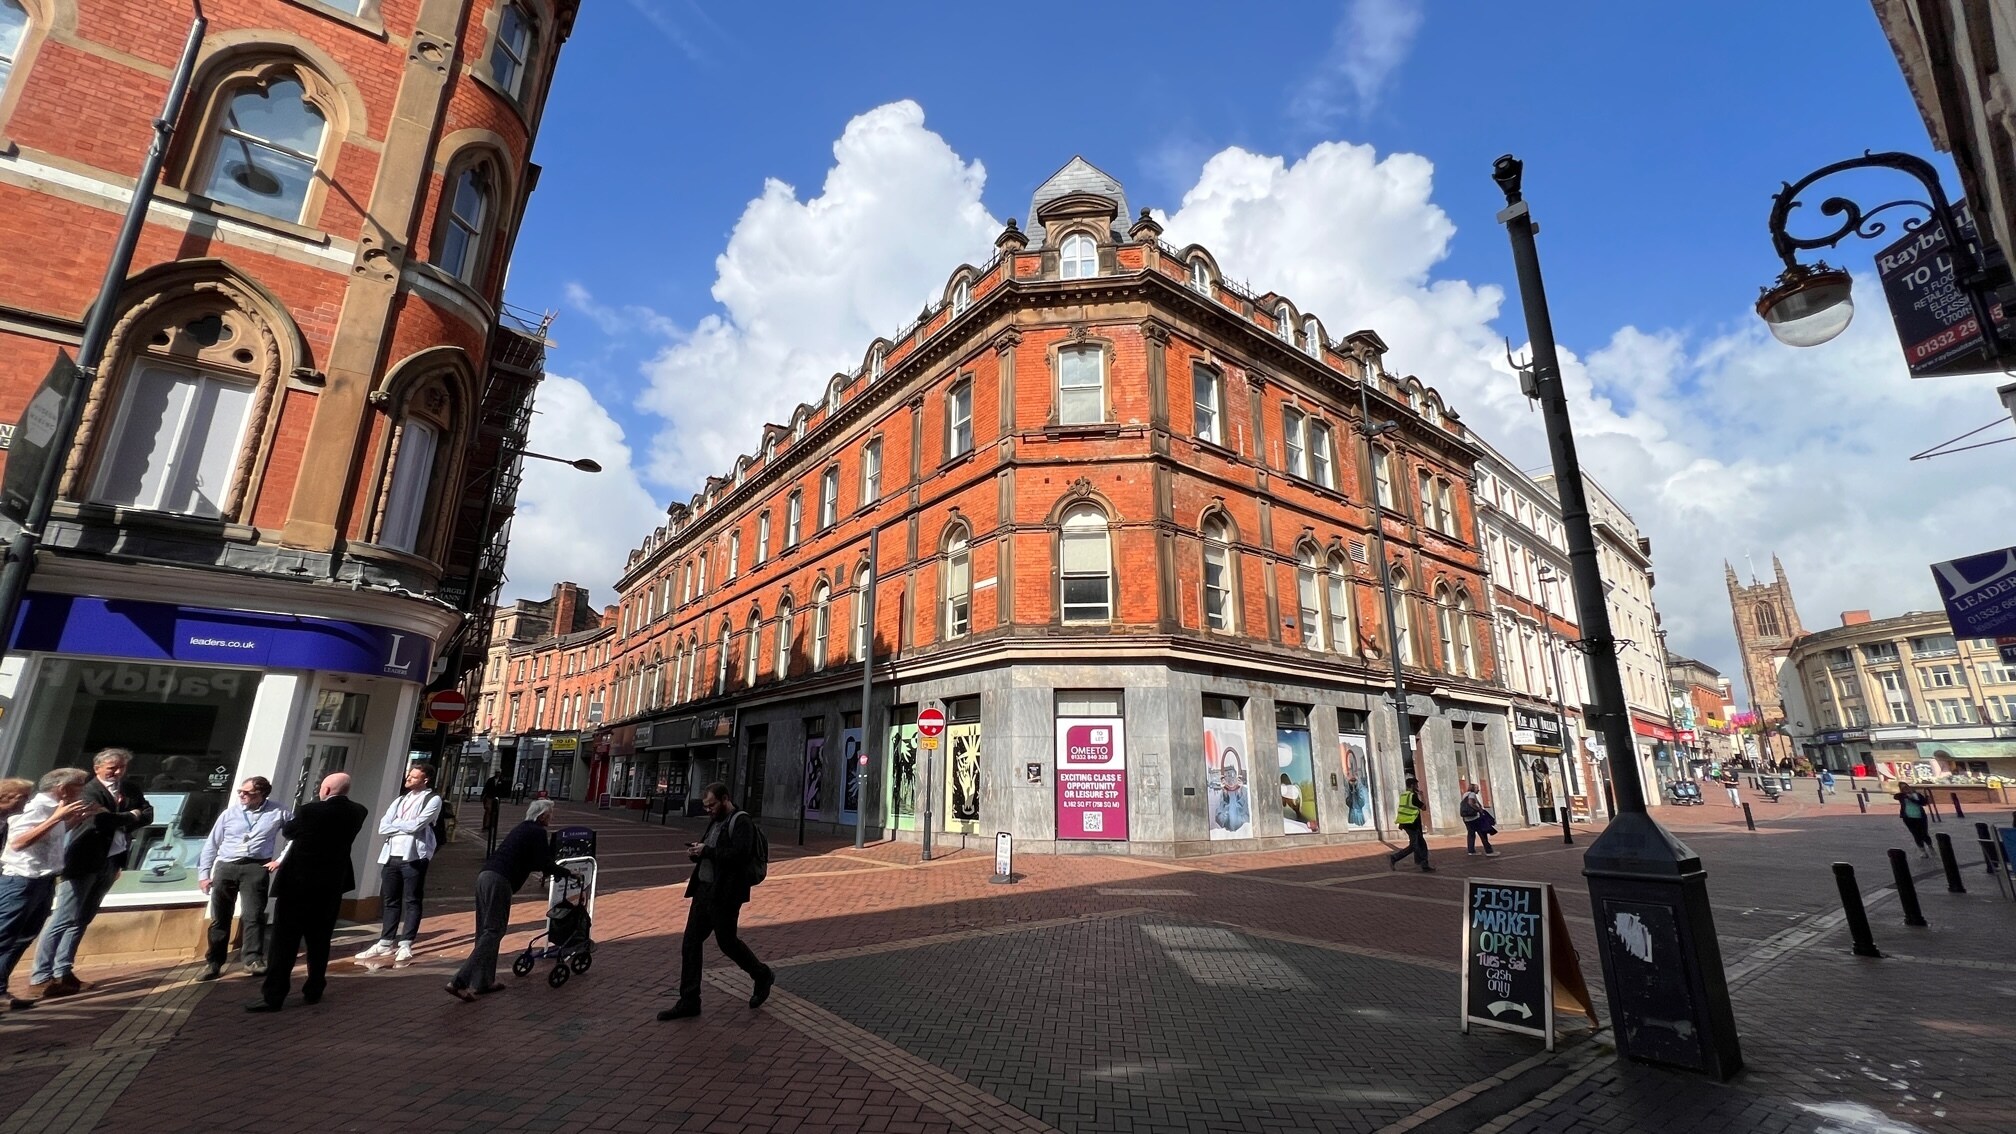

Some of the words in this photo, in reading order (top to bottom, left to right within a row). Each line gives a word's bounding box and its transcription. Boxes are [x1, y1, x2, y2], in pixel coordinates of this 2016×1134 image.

[1902, 266, 1931, 291] TO
[1924, 286, 1930, 296] 3
[1916, 331, 1956, 358] 01332
[1968, 605, 2001, 624] 01332
[2002, 597, 2016, 610] 66
[190, 636, 254, 650] leaders.co.uk
[384, 634, 410, 670] L
[384, 666, 408, 676] LEADERS
[1070, 746, 1108, 754] OMEETO
[1473, 888, 1530, 912] FISH
[1472, 910, 1540, 936] MARKET
[1480, 932, 1532, 959] OPEN
[1488, 980, 1510, 998] only
